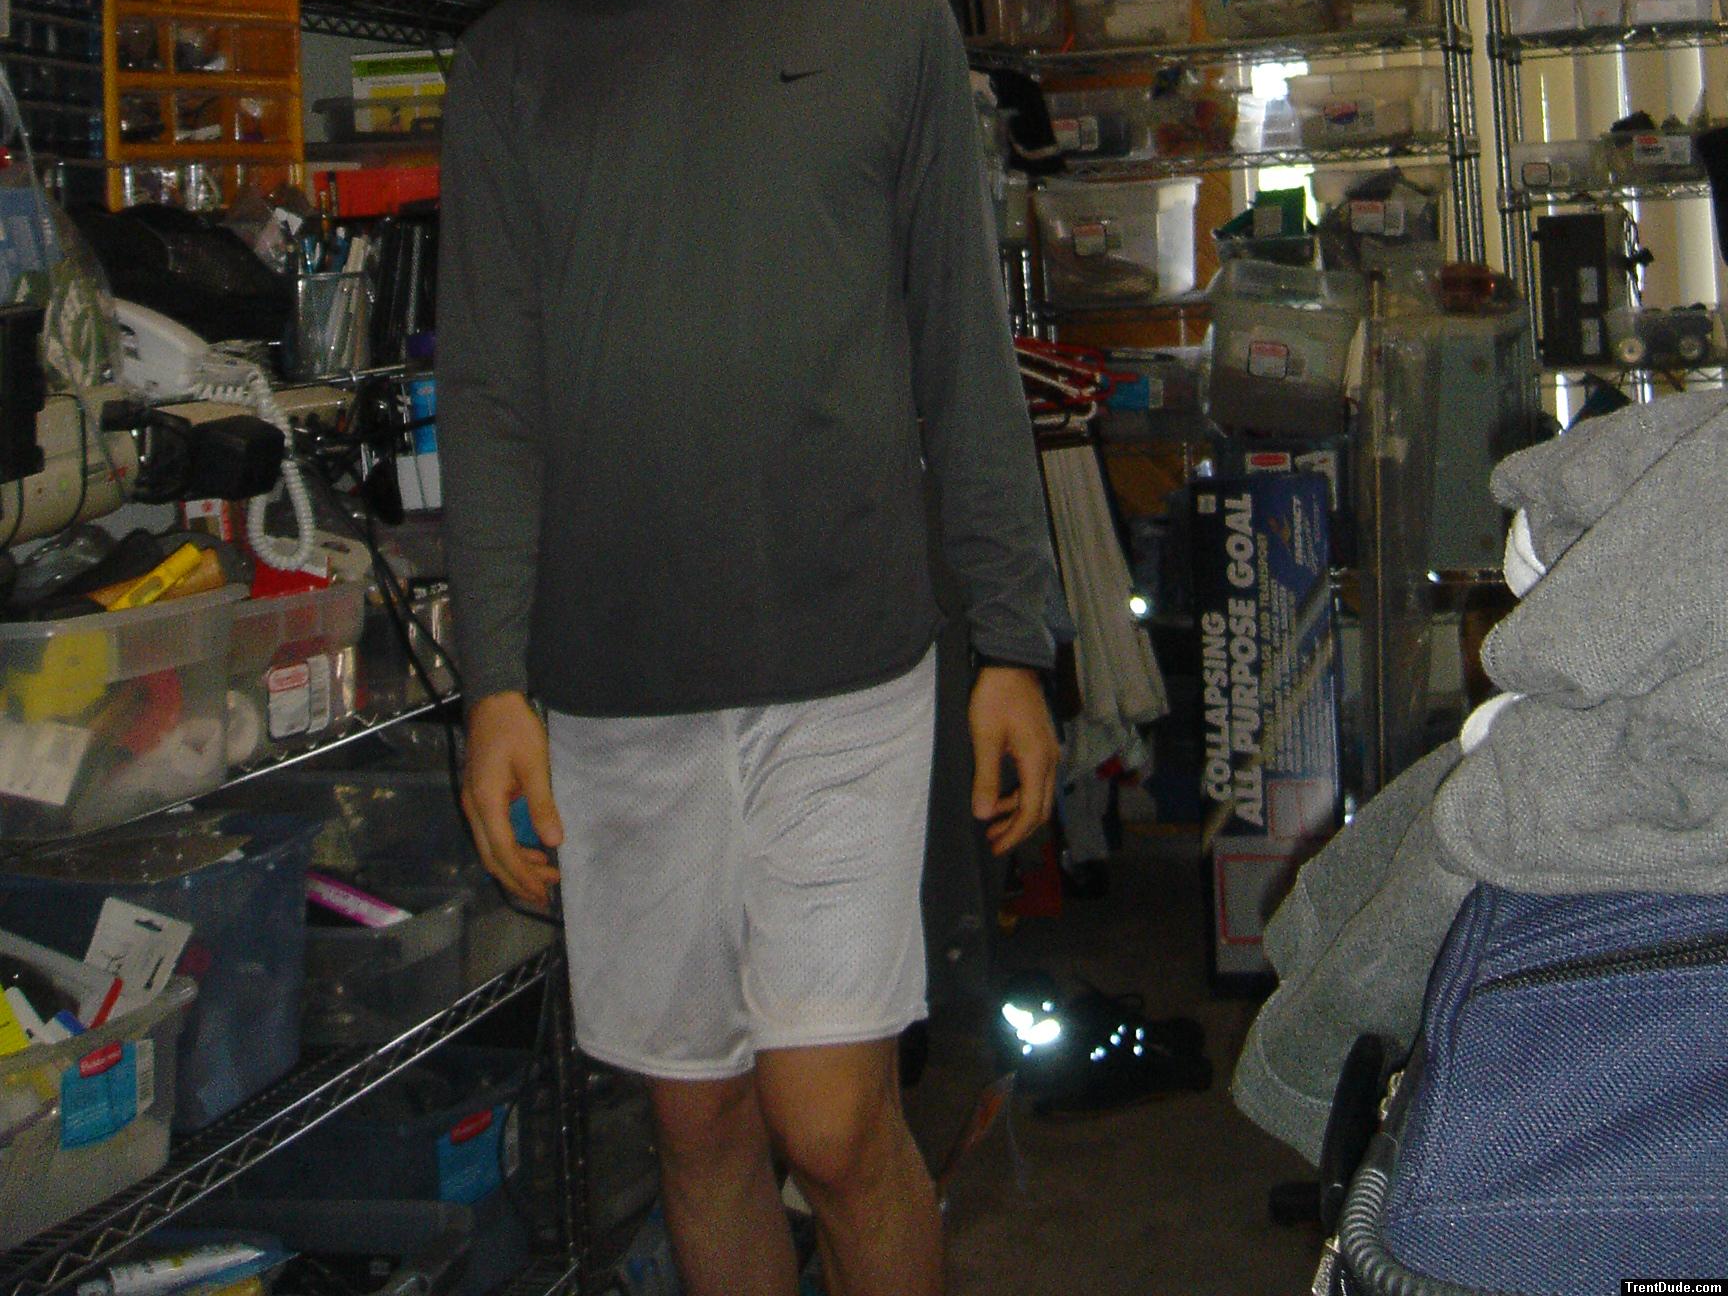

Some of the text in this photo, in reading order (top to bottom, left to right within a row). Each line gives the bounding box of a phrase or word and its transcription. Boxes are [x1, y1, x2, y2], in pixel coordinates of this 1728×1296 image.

[1201, 612, 1232, 801] COLLAPSING
[1224, 493, 1264, 826] ALL PURPOSE GOAL
